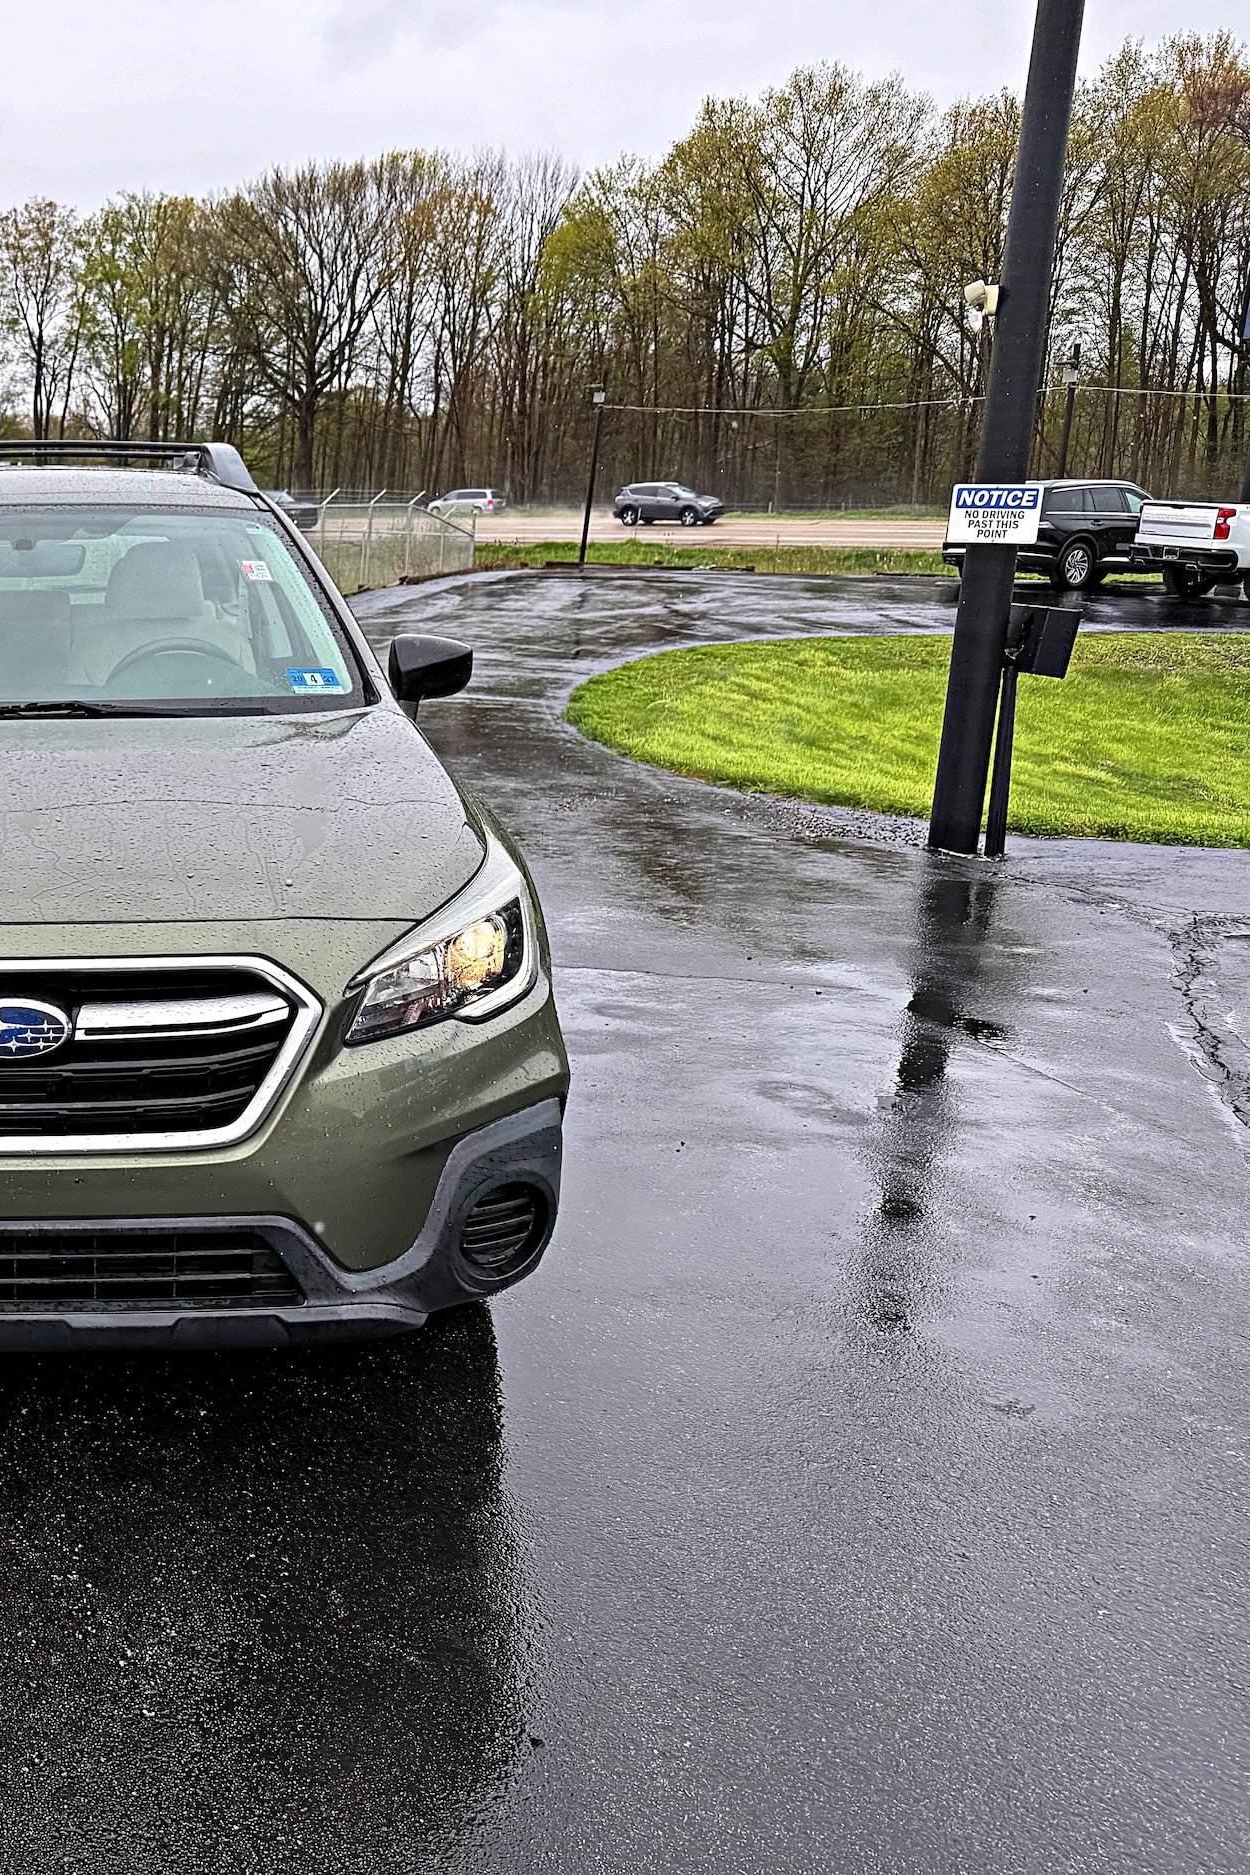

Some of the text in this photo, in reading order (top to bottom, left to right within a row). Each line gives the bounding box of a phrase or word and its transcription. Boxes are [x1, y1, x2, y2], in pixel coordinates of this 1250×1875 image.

[958, 490, 1038, 507] NOTICE
[964, 510, 1025, 519] NO DRIVING
[968, 520, 1019, 529] PAST THIS
[976, 529, 1008, 539] POINT
[310, 674, 318, 684] 4
